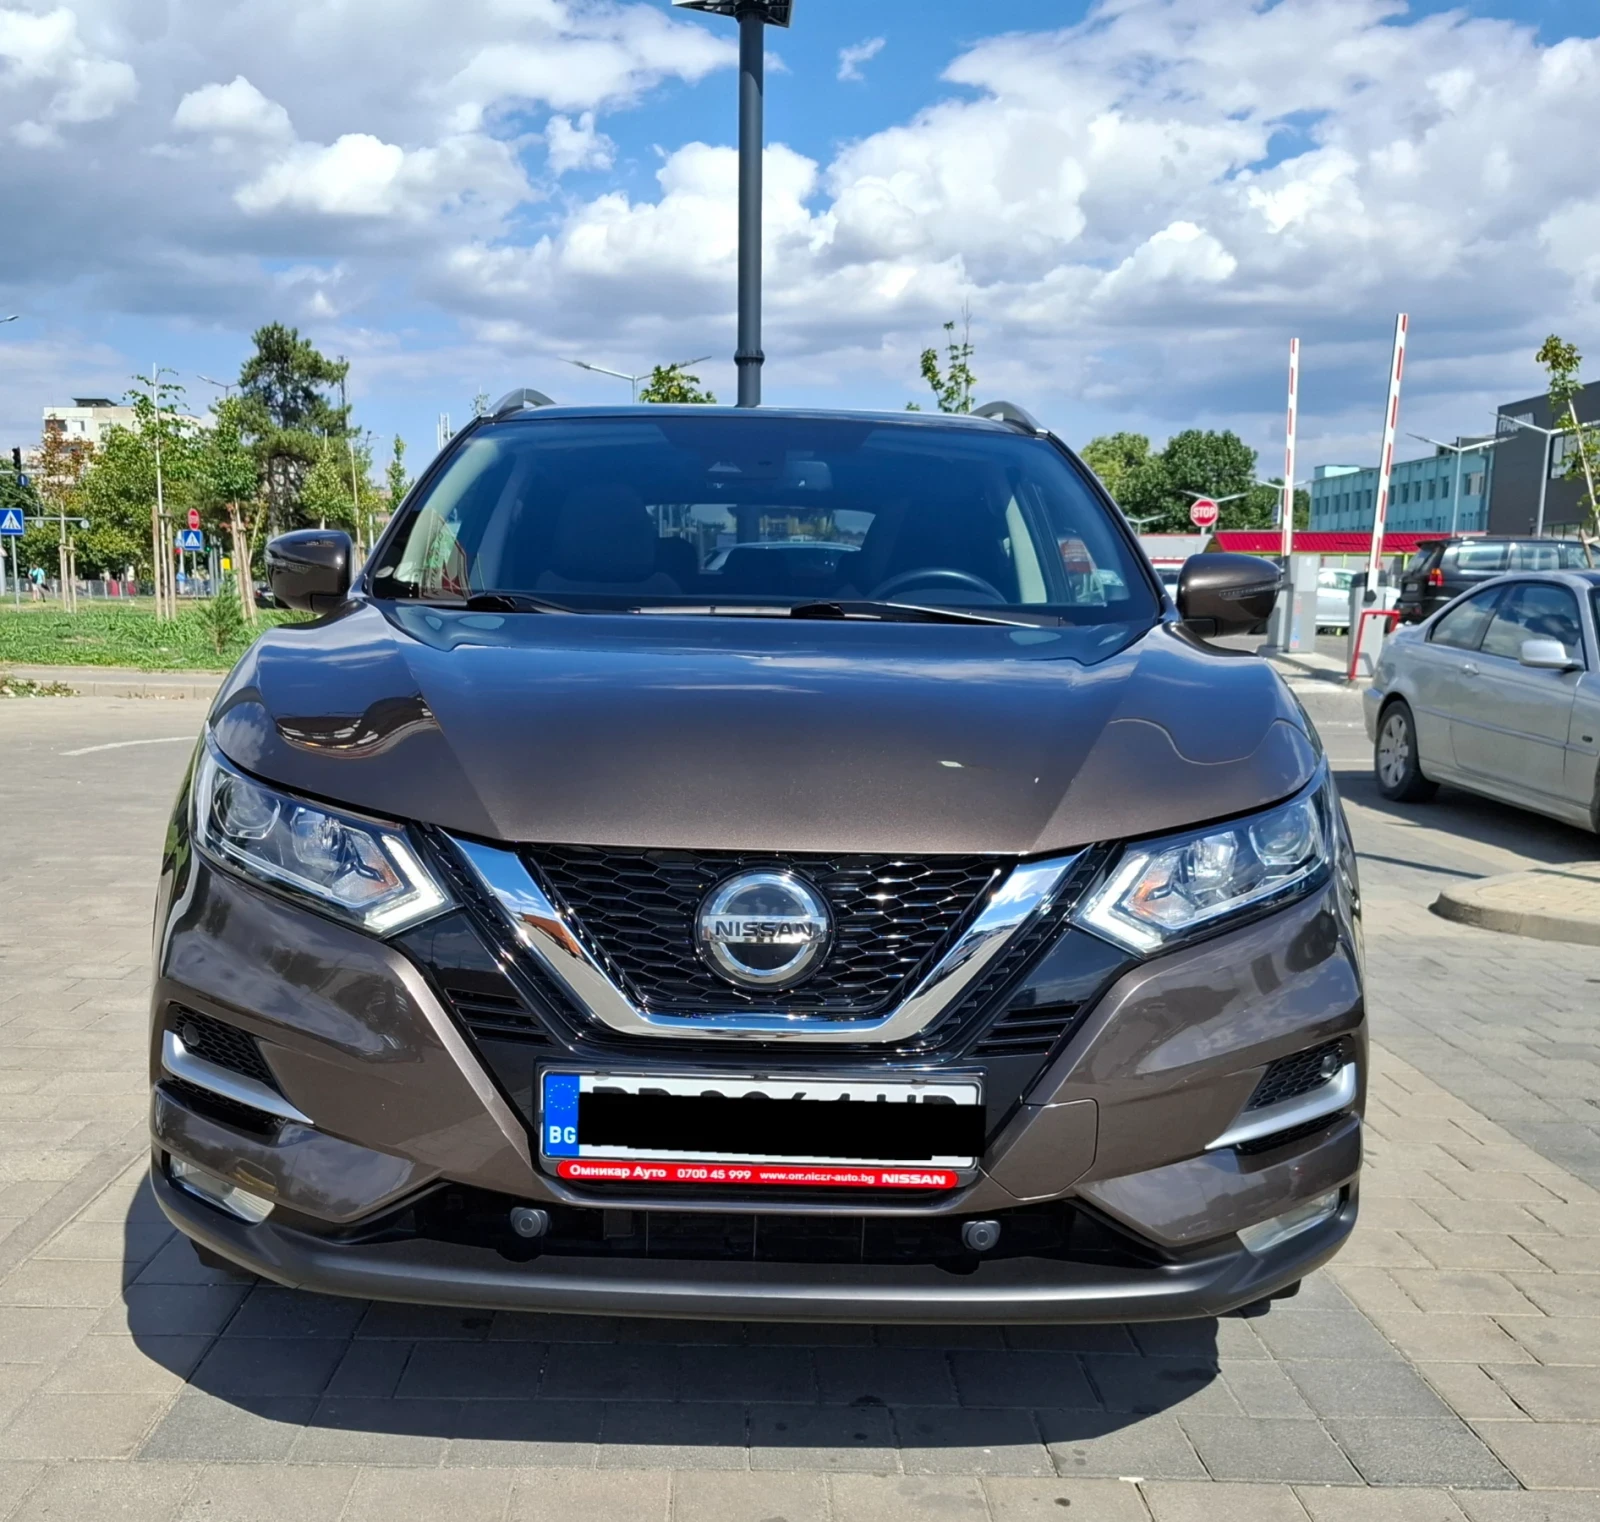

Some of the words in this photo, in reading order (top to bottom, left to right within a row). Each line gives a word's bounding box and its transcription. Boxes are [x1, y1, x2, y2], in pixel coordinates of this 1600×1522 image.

[1193, 506, 1216, 518] STOP
[715, 920, 812, 937] NISSAN
[549, 1125, 576, 1144] BG
[569, 1164, 630, 1179] Омникар
[633, 1165, 667, 1180] Ауто
[677, 1168, 707, 1179] 0700
[709, 1169, 726, 1180] 45
[728, 1169, 752, 1180] 999
[881, 1173, 946, 1185] NISSAN
